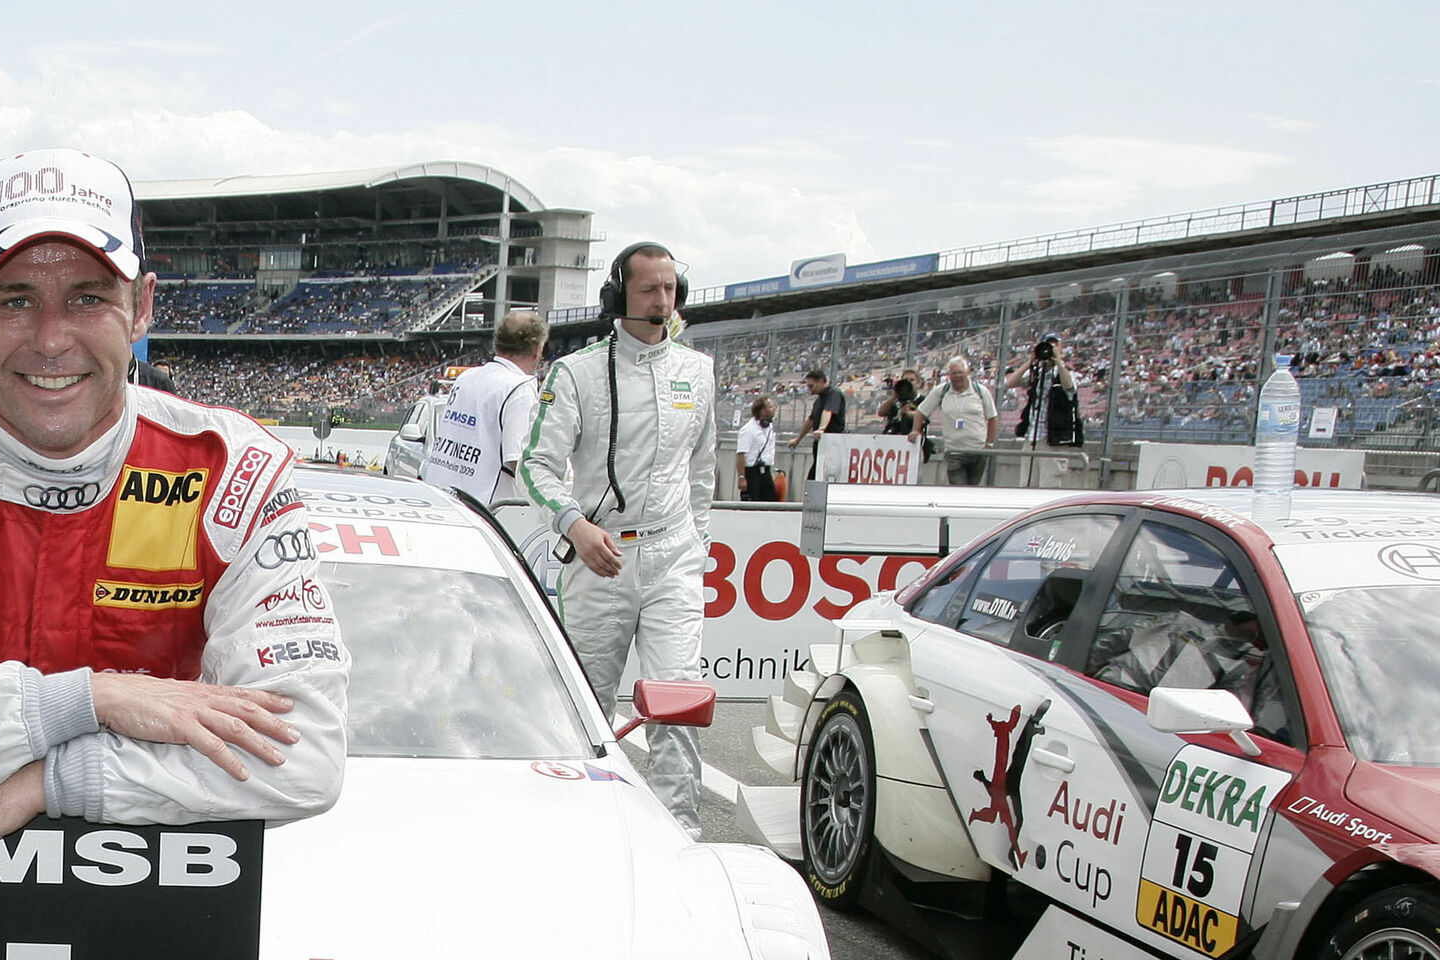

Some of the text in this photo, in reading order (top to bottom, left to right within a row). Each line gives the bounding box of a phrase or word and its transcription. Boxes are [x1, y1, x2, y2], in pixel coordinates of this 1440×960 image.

[71, 185, 112, 208] Jahre
[81, 199, 111, 216] Technik
[444, 409, 477, 427] DMSB
[848, 448, 910, 484] BOSCH
[120, 469, 203, 505] ADAC
[218, 449, 271, 526] sparco
[1199, 507, 1246, 528] Sport
[1036, 535, 1076, 561] Jarvis
[111, 584, 203, 605] DUNLOP
[972, 597, 1018, 621] www.DTM.tv
[1047, 781, 1126, 846] Audi
[1161, 759, 1268, 835] DEKRA
[1309, 804, 1392, 845] Audi Sport
[1055, 839, 1112, 909] Cup
[1171, 834, 1220, 899] 15
[1153, 889, 1220, 955] ADAC
